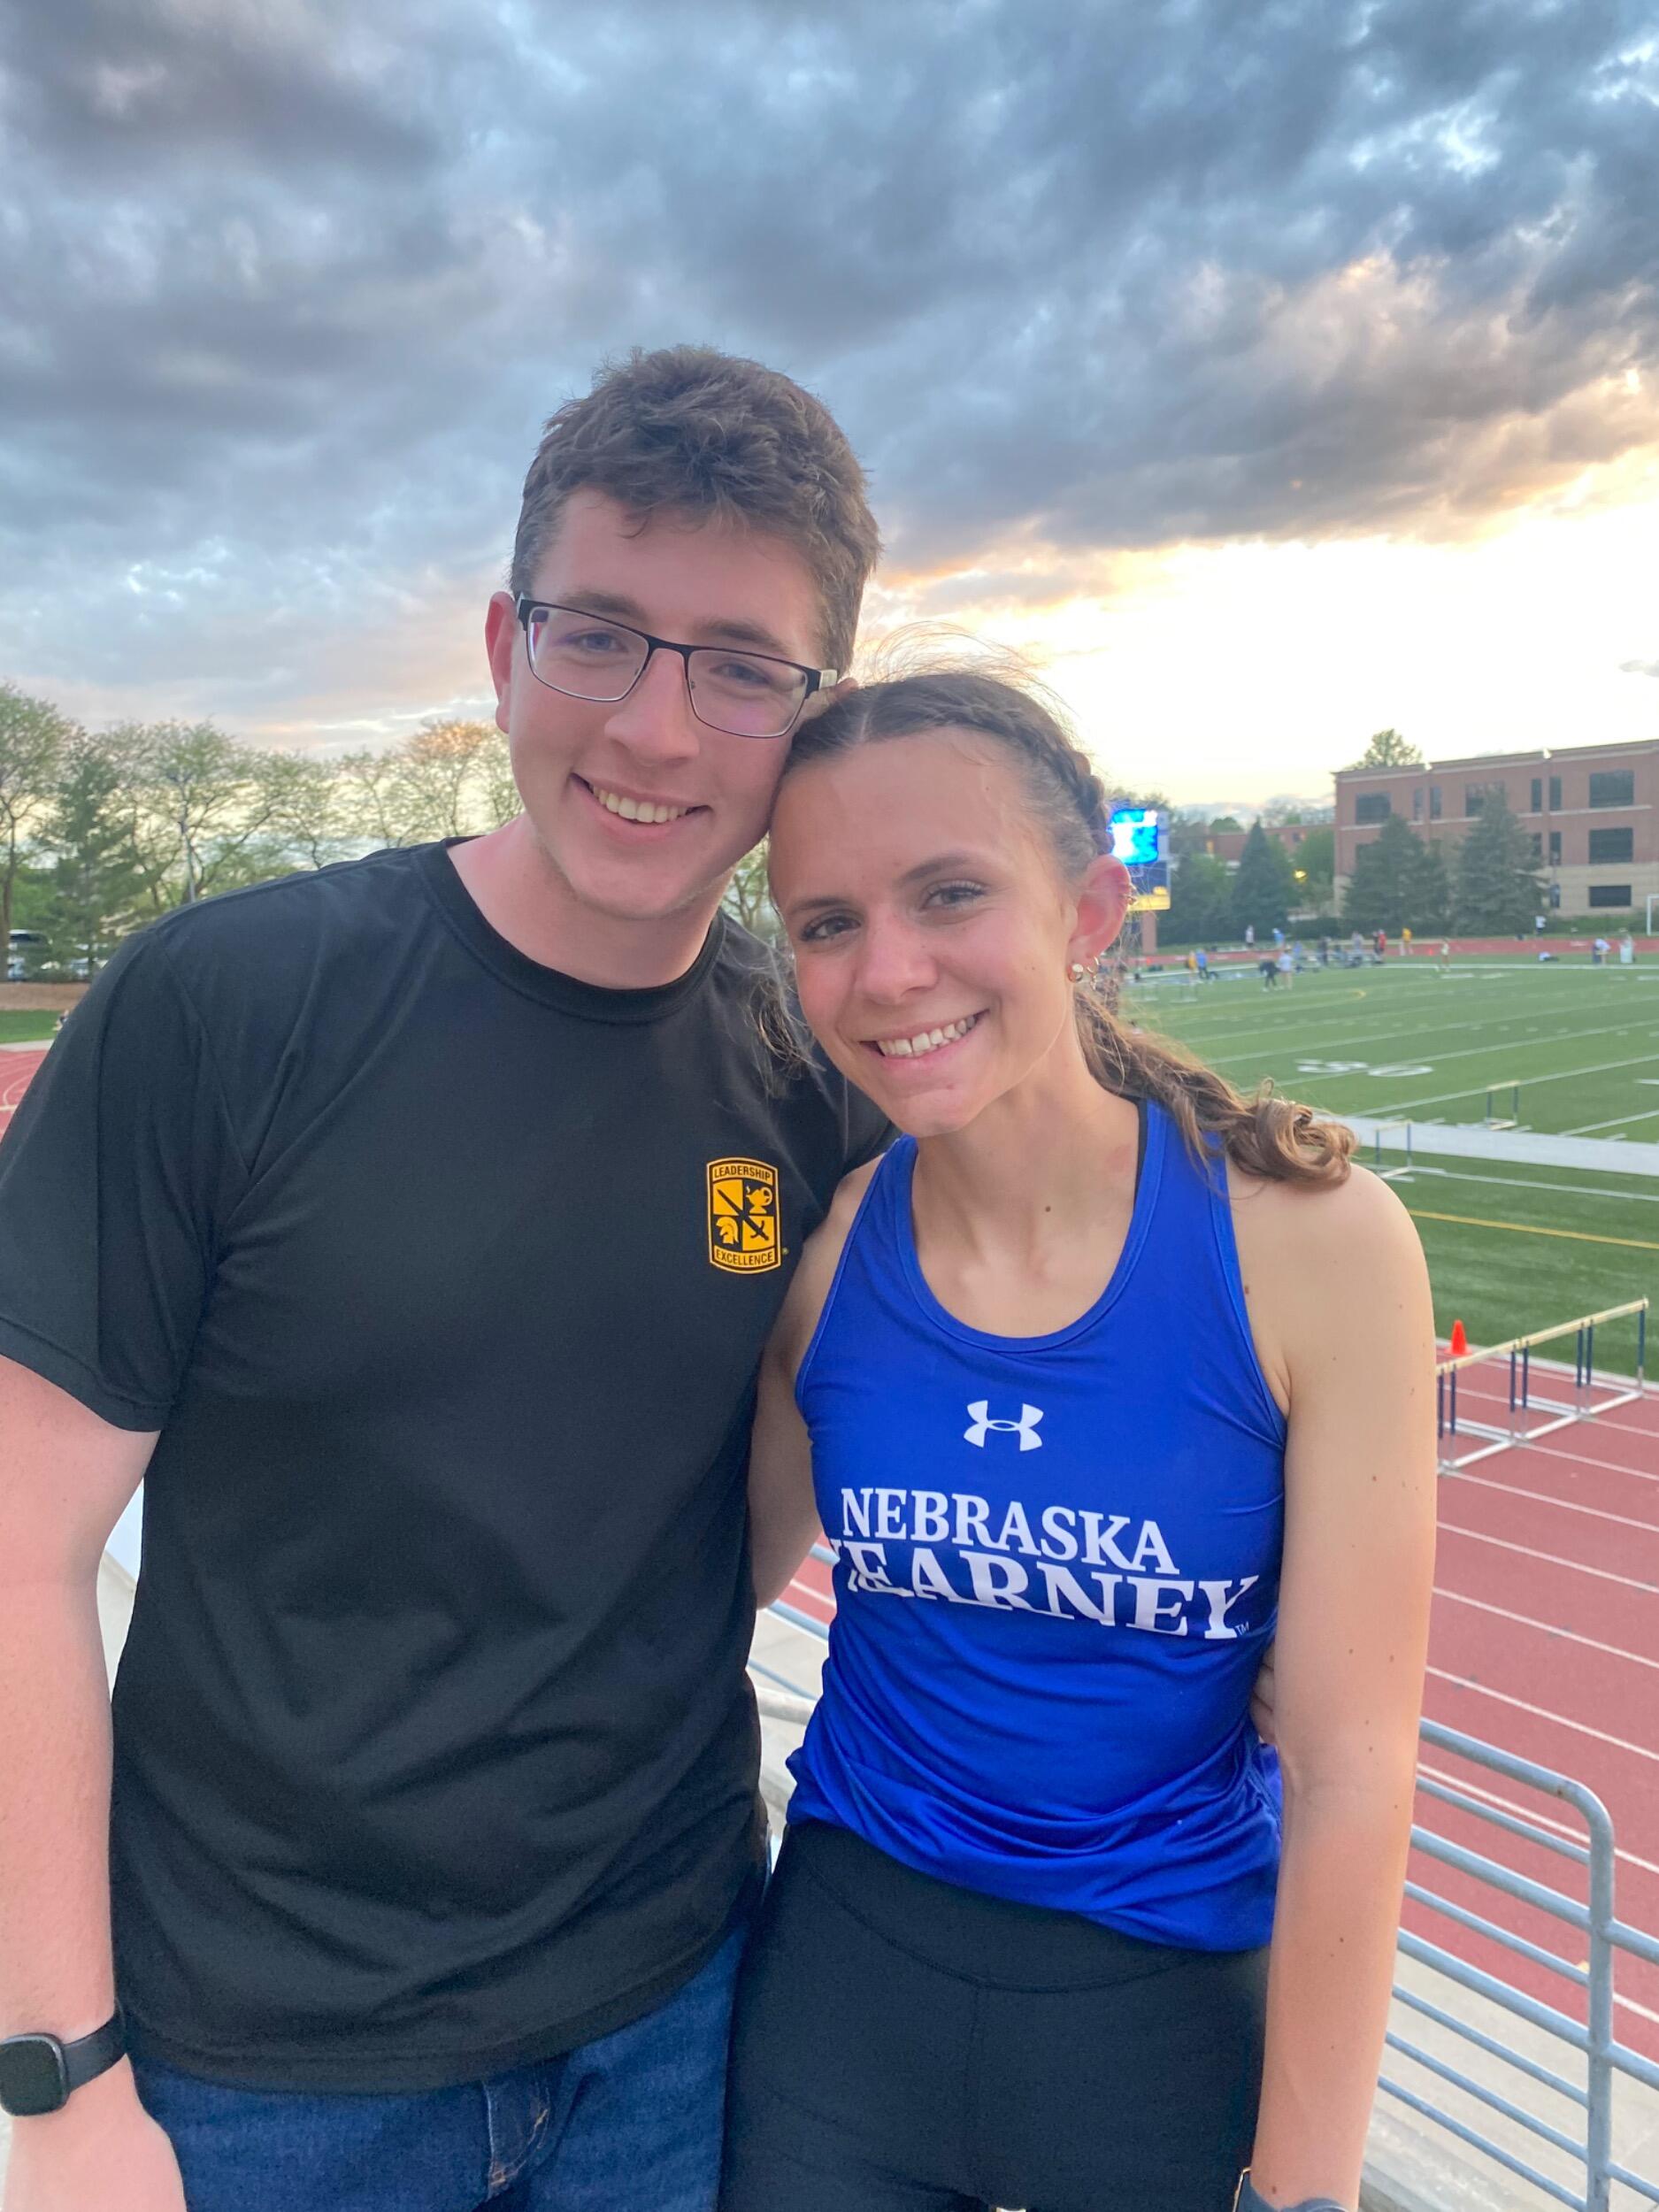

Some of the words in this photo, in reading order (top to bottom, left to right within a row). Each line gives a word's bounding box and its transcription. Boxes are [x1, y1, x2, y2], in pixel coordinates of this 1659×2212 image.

[714, 1165, 771, 1181] LEADERSHIP
[716, 1248, 772, 1266] EXCELLENCE
[841, 1487, 1180, 1575] NEBRASKA
